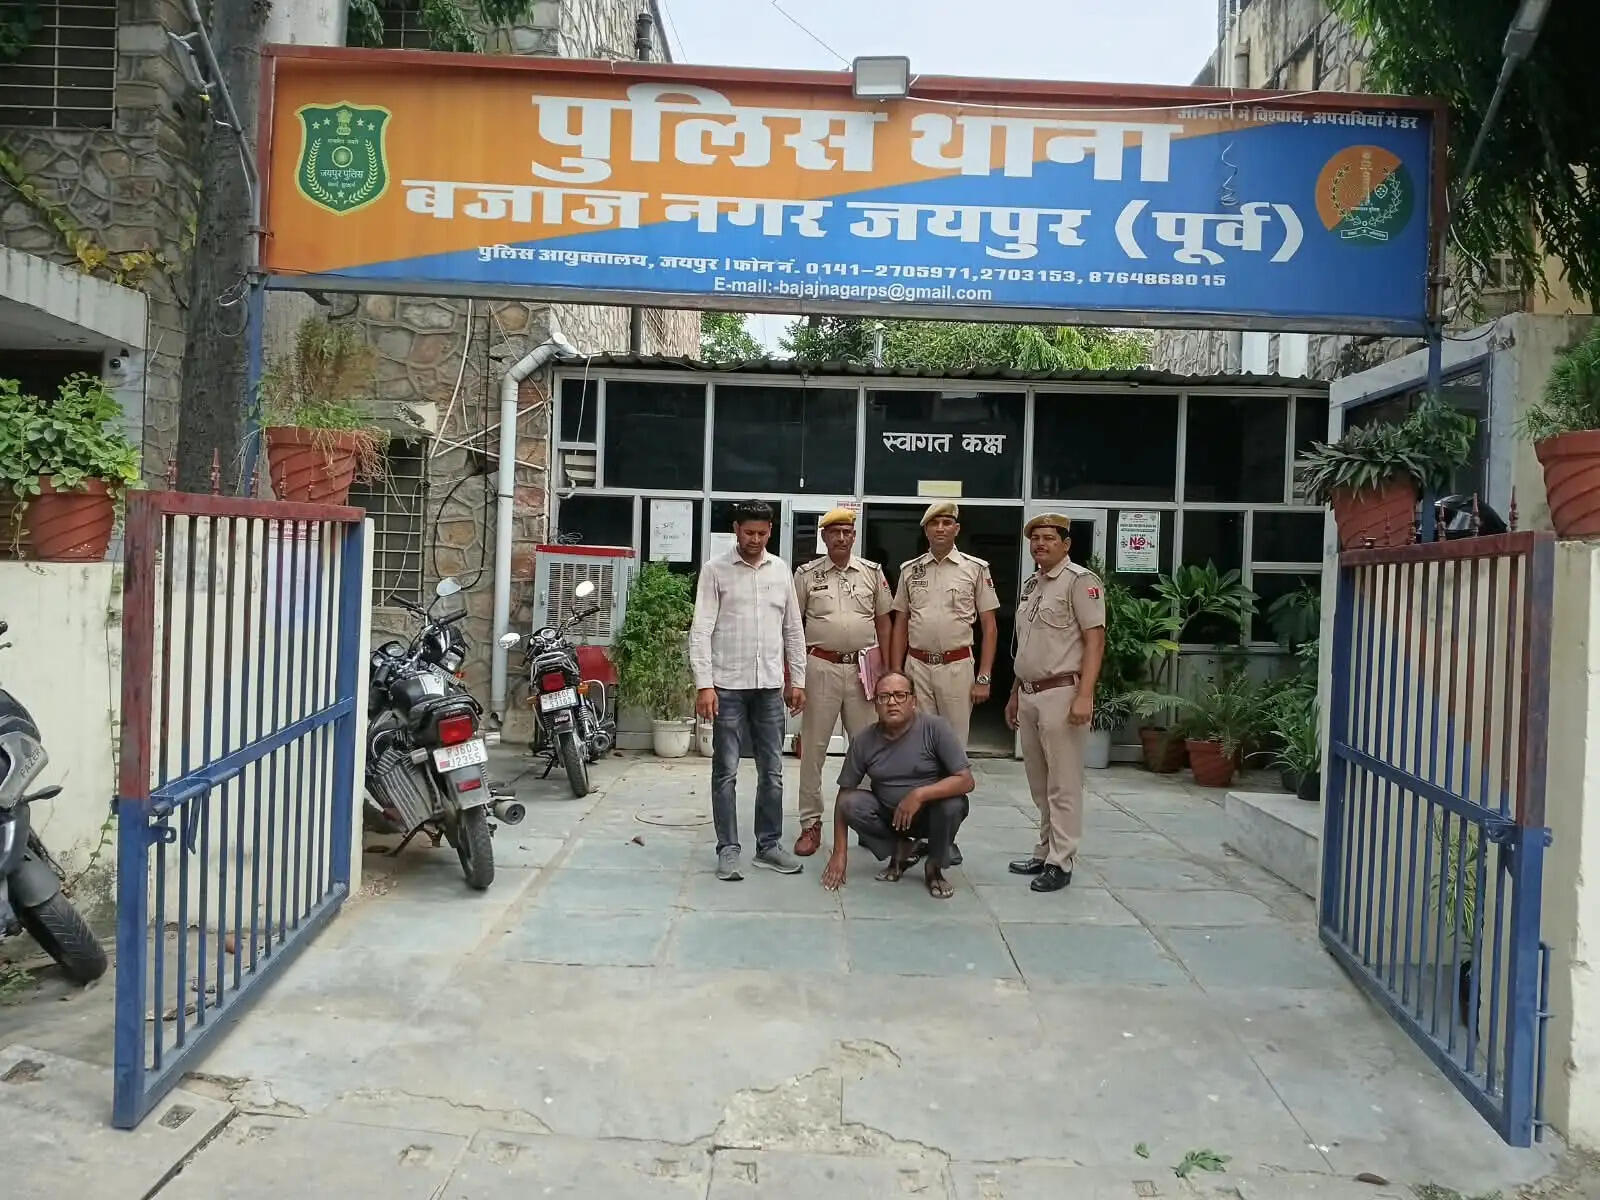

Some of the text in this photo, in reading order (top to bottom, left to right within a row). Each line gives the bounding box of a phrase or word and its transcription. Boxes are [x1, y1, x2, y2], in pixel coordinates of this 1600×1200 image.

[532, 82, 1184, 183] पुलिस थाना
[401, 180, 1304, 264] बजाज नगर जयपुर (पूर्व)
[478, 244, 536, 262] पुलिस
[659, 256, 719, 273] जयपुर
[882, 432, 1007, 456] स्वागत कक्ष
